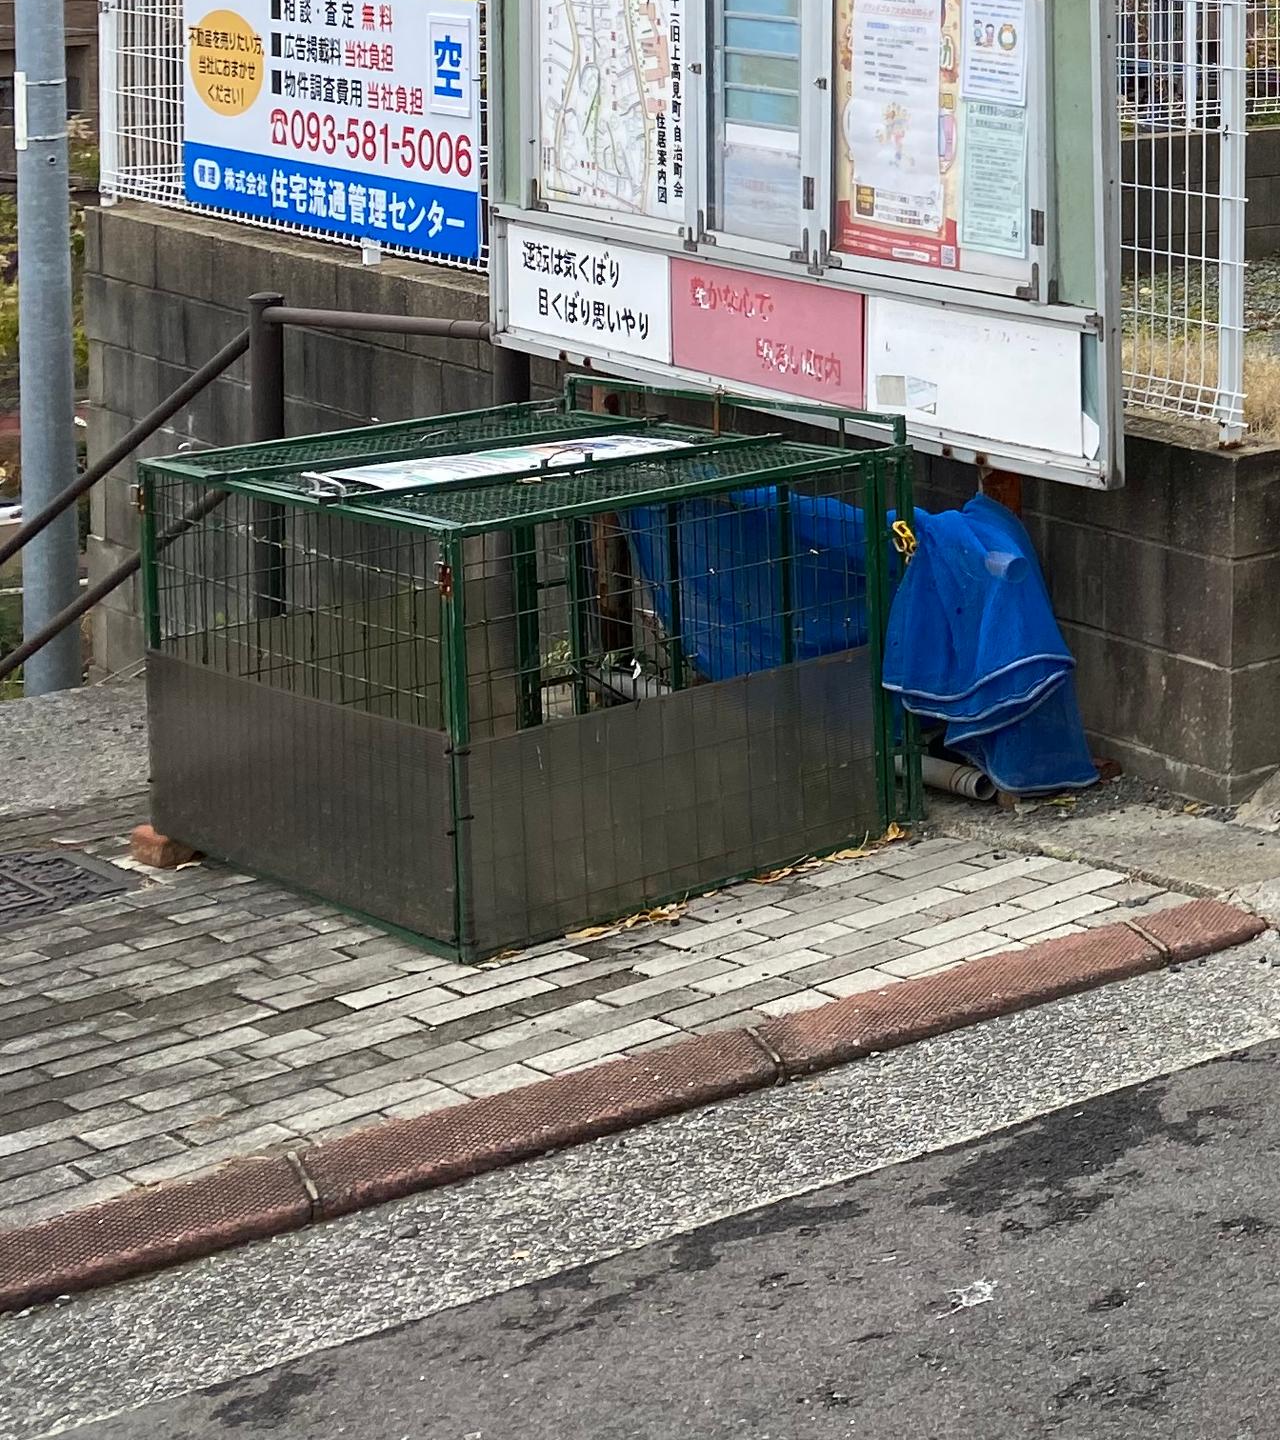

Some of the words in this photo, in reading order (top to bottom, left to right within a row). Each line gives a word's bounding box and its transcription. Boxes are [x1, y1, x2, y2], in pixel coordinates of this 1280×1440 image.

[362, 2, 393, 33] 無料
[198, 55, 256, 80] 当社におまかせ
[283, 33, 341, 66] 広告掲載料
[345, 40, 394, 72] 当社負担
[433, 34, 463, 98] 空
[284, 70, 362, 107] 物件調査費用
[367, 81, 424, 116] 当社負担
[290, 111, 473, 177] 093-581-5006
[224, 167, 268, 197] 株式会社
[270, 168, 465, 238] 住宅流通管理センター
[522, 240, 620, 288] 運転は気くばり
[538, 288, 649, 340] 目くばり思いやり
